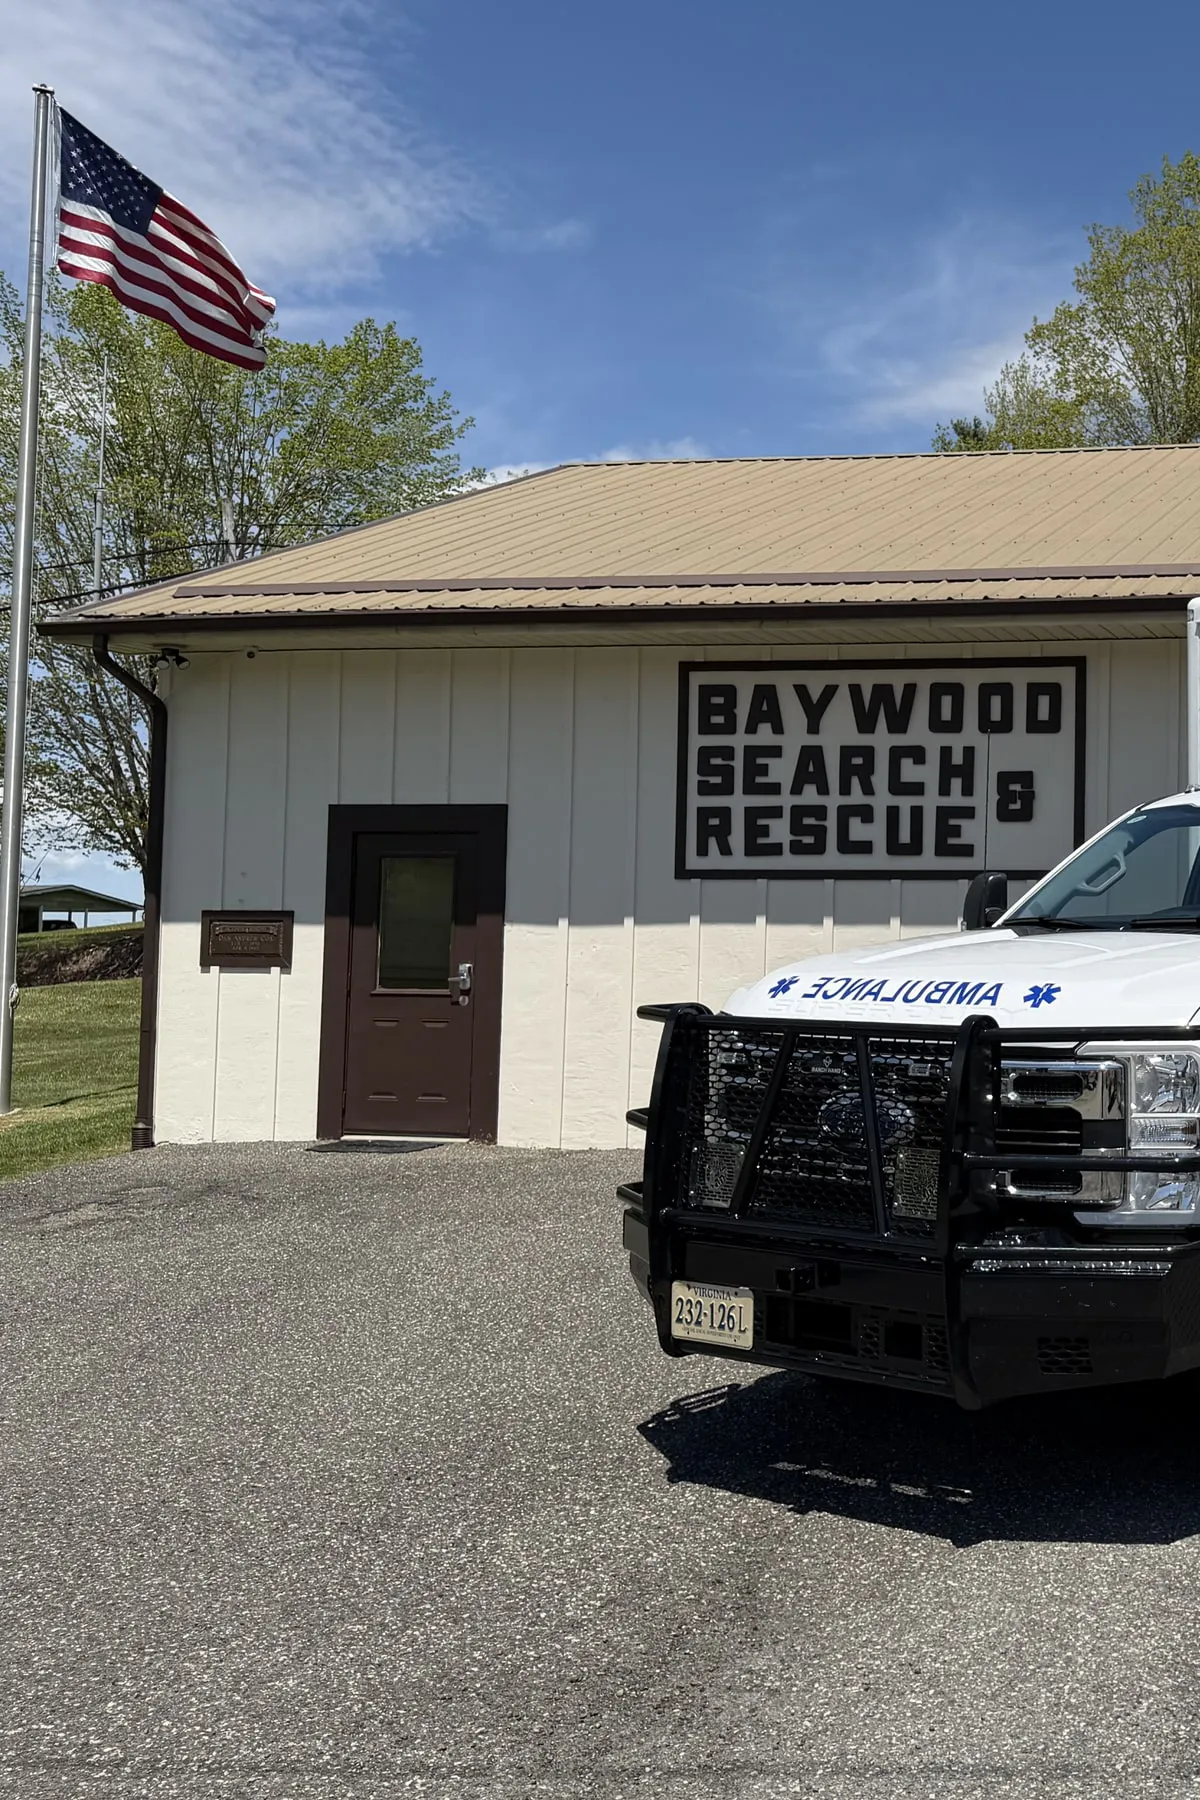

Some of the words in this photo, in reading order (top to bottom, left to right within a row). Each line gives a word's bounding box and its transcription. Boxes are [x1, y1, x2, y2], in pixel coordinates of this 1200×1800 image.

[697, 682, 1063, 736] BAYWOOD
[696, 745, 976, 797] SEARCH
[996, 770, 1036, 823] &
[696, 803, 976, 858] RESCUE
[693, 1286, 732, 1301] VIRGINIA
